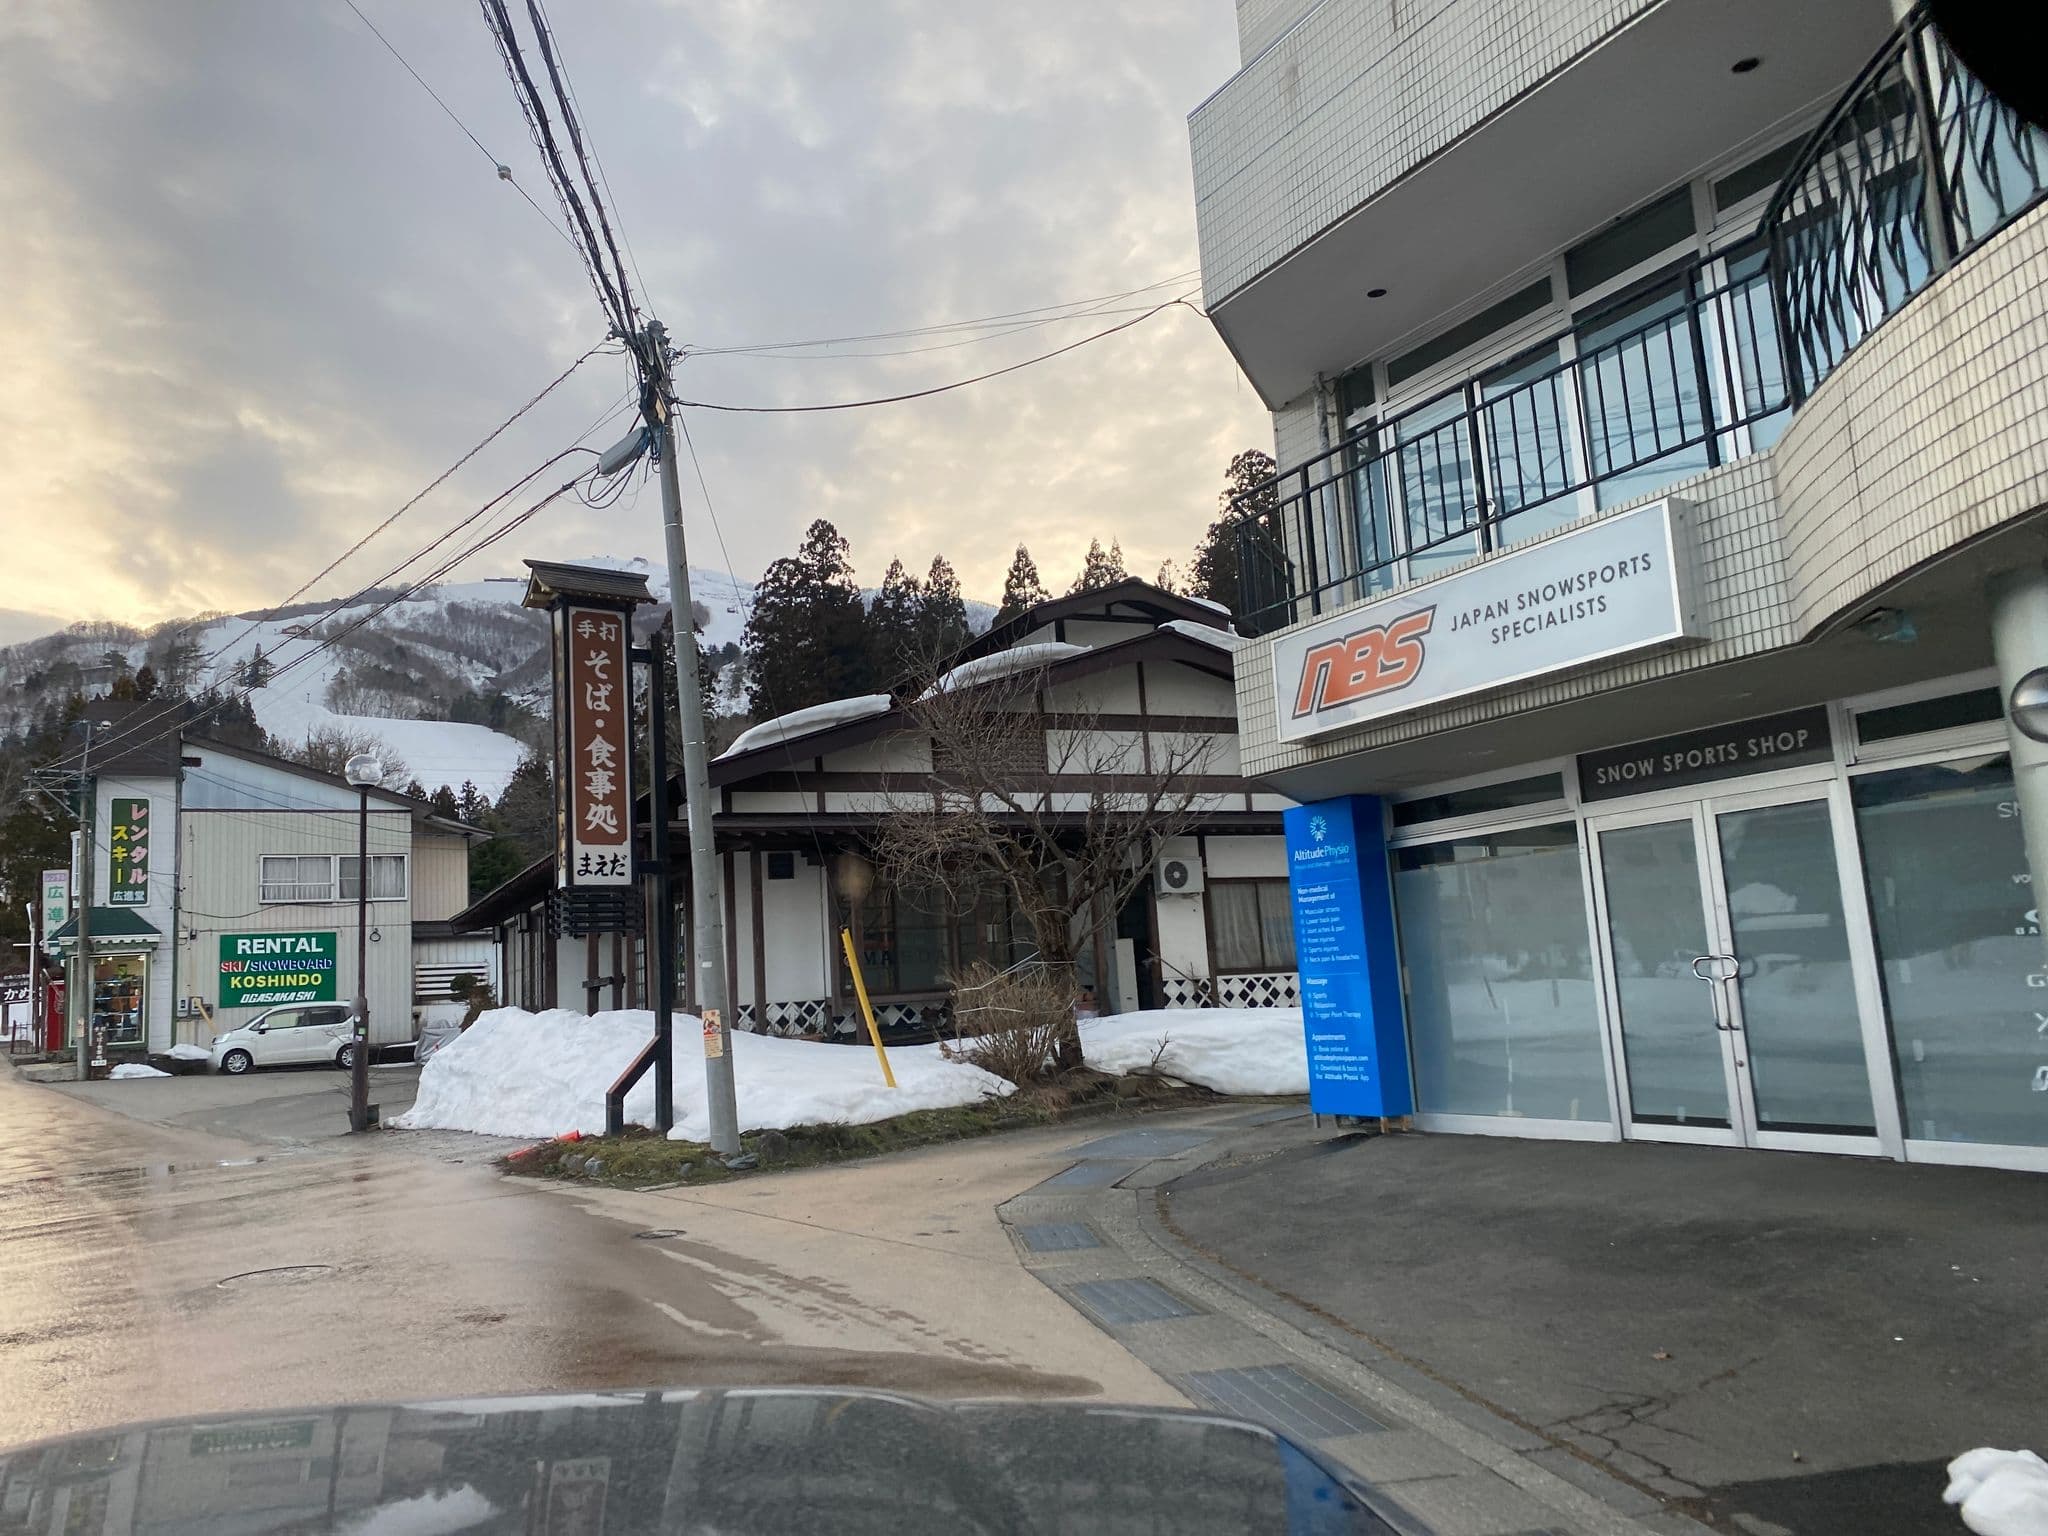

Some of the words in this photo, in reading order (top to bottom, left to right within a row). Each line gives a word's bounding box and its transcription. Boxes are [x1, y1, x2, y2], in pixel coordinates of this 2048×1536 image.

[1451, 599, 1509, 632] JAPAN
[1517, 553, 1651, 611] SNOWSPORTS
[577, 619, 618, 642] 手打
[1491, 595, 1607, 644] SPECIALISTS
[584, 649, 618, 834] そば・食事処
[1596, 758, 1654, 784] SNOW
[1663, 743, 1738, 772] SPORTS
[1748, 729, 1809, 757] SHOP
[112, 825, 129, 884] スキー
[128, 803, 148, 885] レンタル
[577, 852, 628, 877] まえだ
[237, 937, 323, 954] RENTAL
[230, 973, 322, 989] KOSHINDO
[240, 991, 294, 1004] OGASAKA
